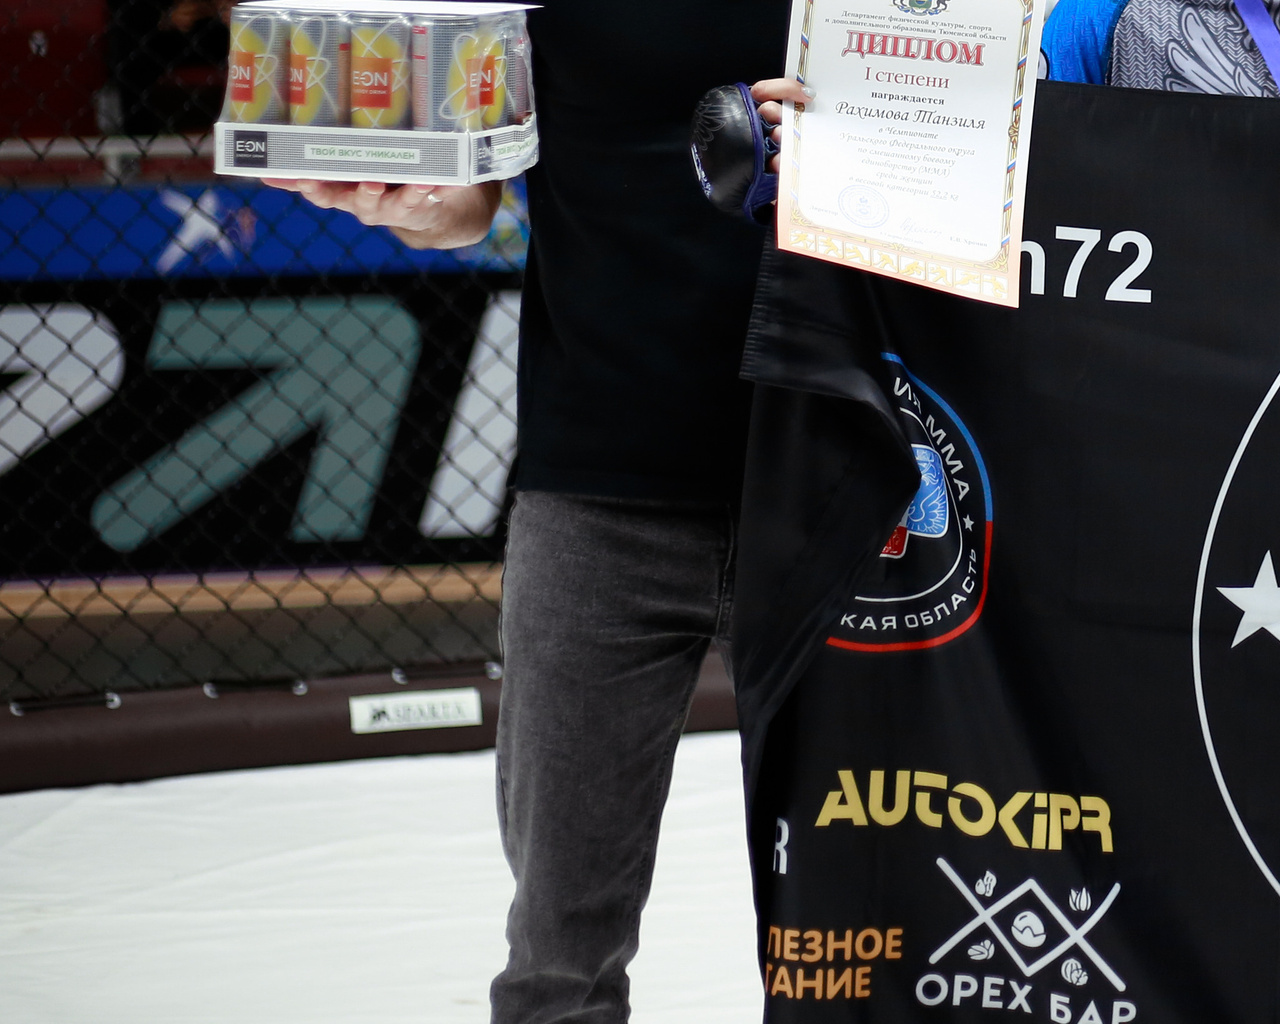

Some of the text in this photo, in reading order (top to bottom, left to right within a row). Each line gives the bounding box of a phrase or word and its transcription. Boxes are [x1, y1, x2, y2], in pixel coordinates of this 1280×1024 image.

[831, 18, 890, 30] дополнительного
[892, 24, 937, 35] образования
[939, 28, 977, 39] Тюменской
[979, 32, 1007, 41] области
[841, 10, 886, 21] Департамент
[888, 14, 929, 26] физической
[969, 24, 992, 32] спорта
[841, 30, 986, 66] ДИПЛОМ
[875, 70, 950, 89] степени
[871, 91, 945, 105] награждается
[835, 101, 986, 130] Рахимова Танзиля
[885, 126, 939, 140] Чемпионате
[236, 140, 265, 152] EON
[310, 147, 415, 160] ТВОЙ ВКУС УНИКАЛЕН
[839, 132, 976, 157] Уральского Федерального округа
[857, 146, 956, 168] по смешанному боевому
[861, 157, 917, 173] единоборству
[855, 177, 884, 188] весовой
[886, 182, 929, 196] категории
[876, 170, 933, 185] среди женщин
[925, 414, 971, 502] ММА
[904, 548, 977, 629] ОБЛАСТЬ
[915, 973, 1033, 1014] ОРЕХ
